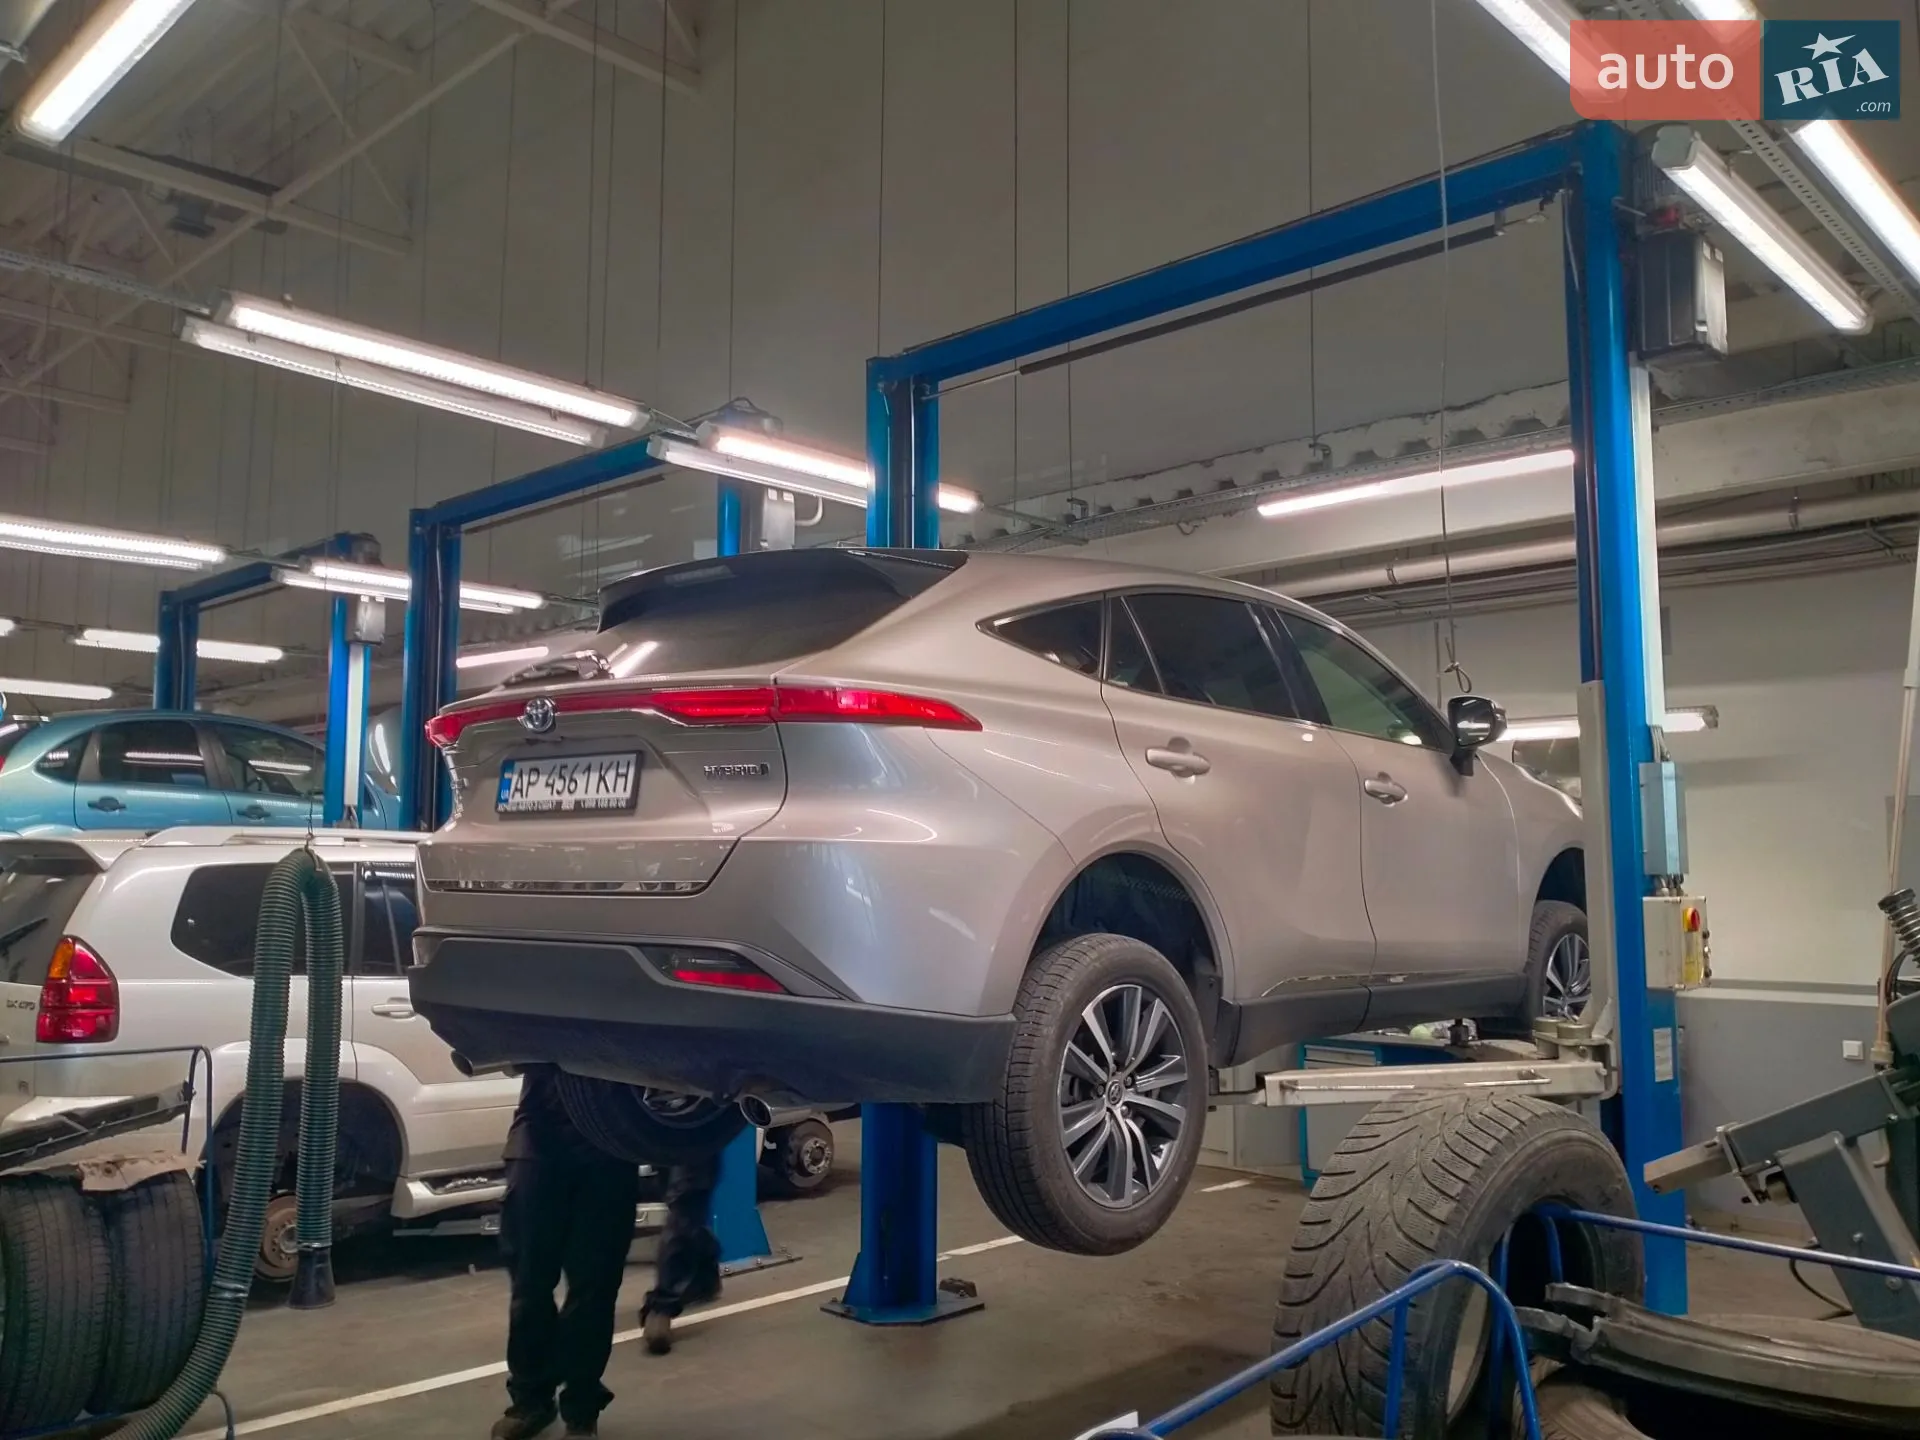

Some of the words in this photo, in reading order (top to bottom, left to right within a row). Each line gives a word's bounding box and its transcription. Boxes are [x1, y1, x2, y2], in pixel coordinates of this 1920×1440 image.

[512, 767, 540, 799] AP
[545, 762, 592, 796] 4561
[596, 760, 630, 794] KH
[703, 764, 760, 776] HYBRID
